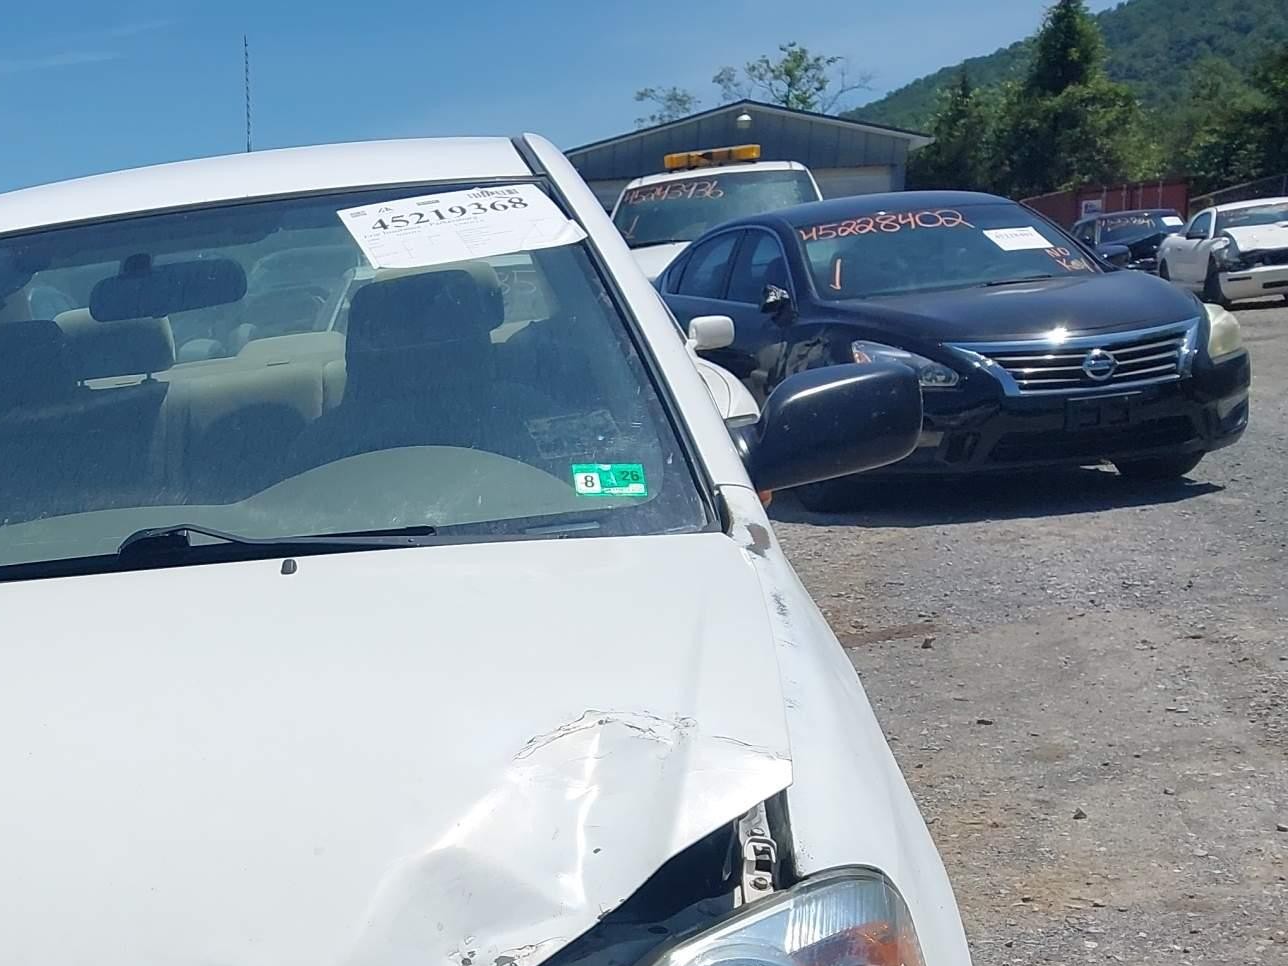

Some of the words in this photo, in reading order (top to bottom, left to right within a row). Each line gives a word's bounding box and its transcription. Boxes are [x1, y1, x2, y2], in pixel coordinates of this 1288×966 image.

[371, 196, 529, 231] 45219368
[800, 210, 976, 241] 45228402
[584, 475, 594, 488] 8
[621, 470, 640, 481] 26
